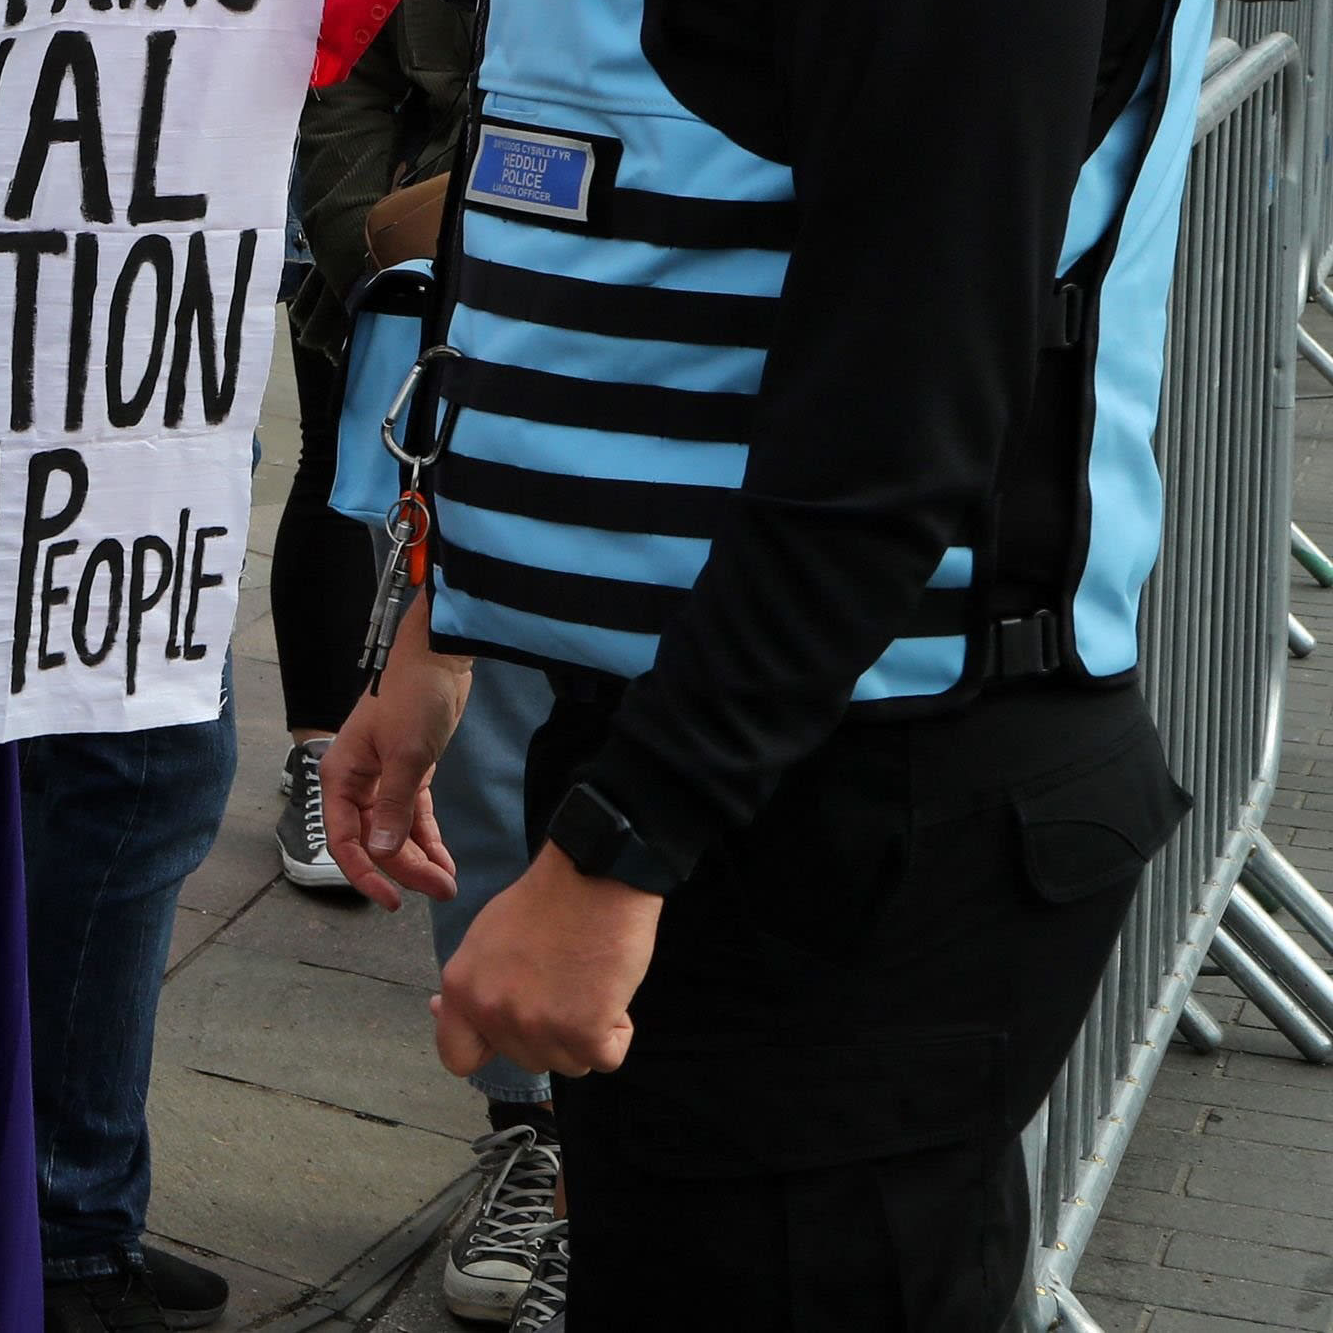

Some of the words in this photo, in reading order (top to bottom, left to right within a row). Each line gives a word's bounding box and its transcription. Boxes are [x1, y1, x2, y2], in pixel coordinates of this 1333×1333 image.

[502, 153, 548, 174] HEDDLU
[501, 168, 543, 189] POLICE
[11, 448, 229, 696] PEOPLE
